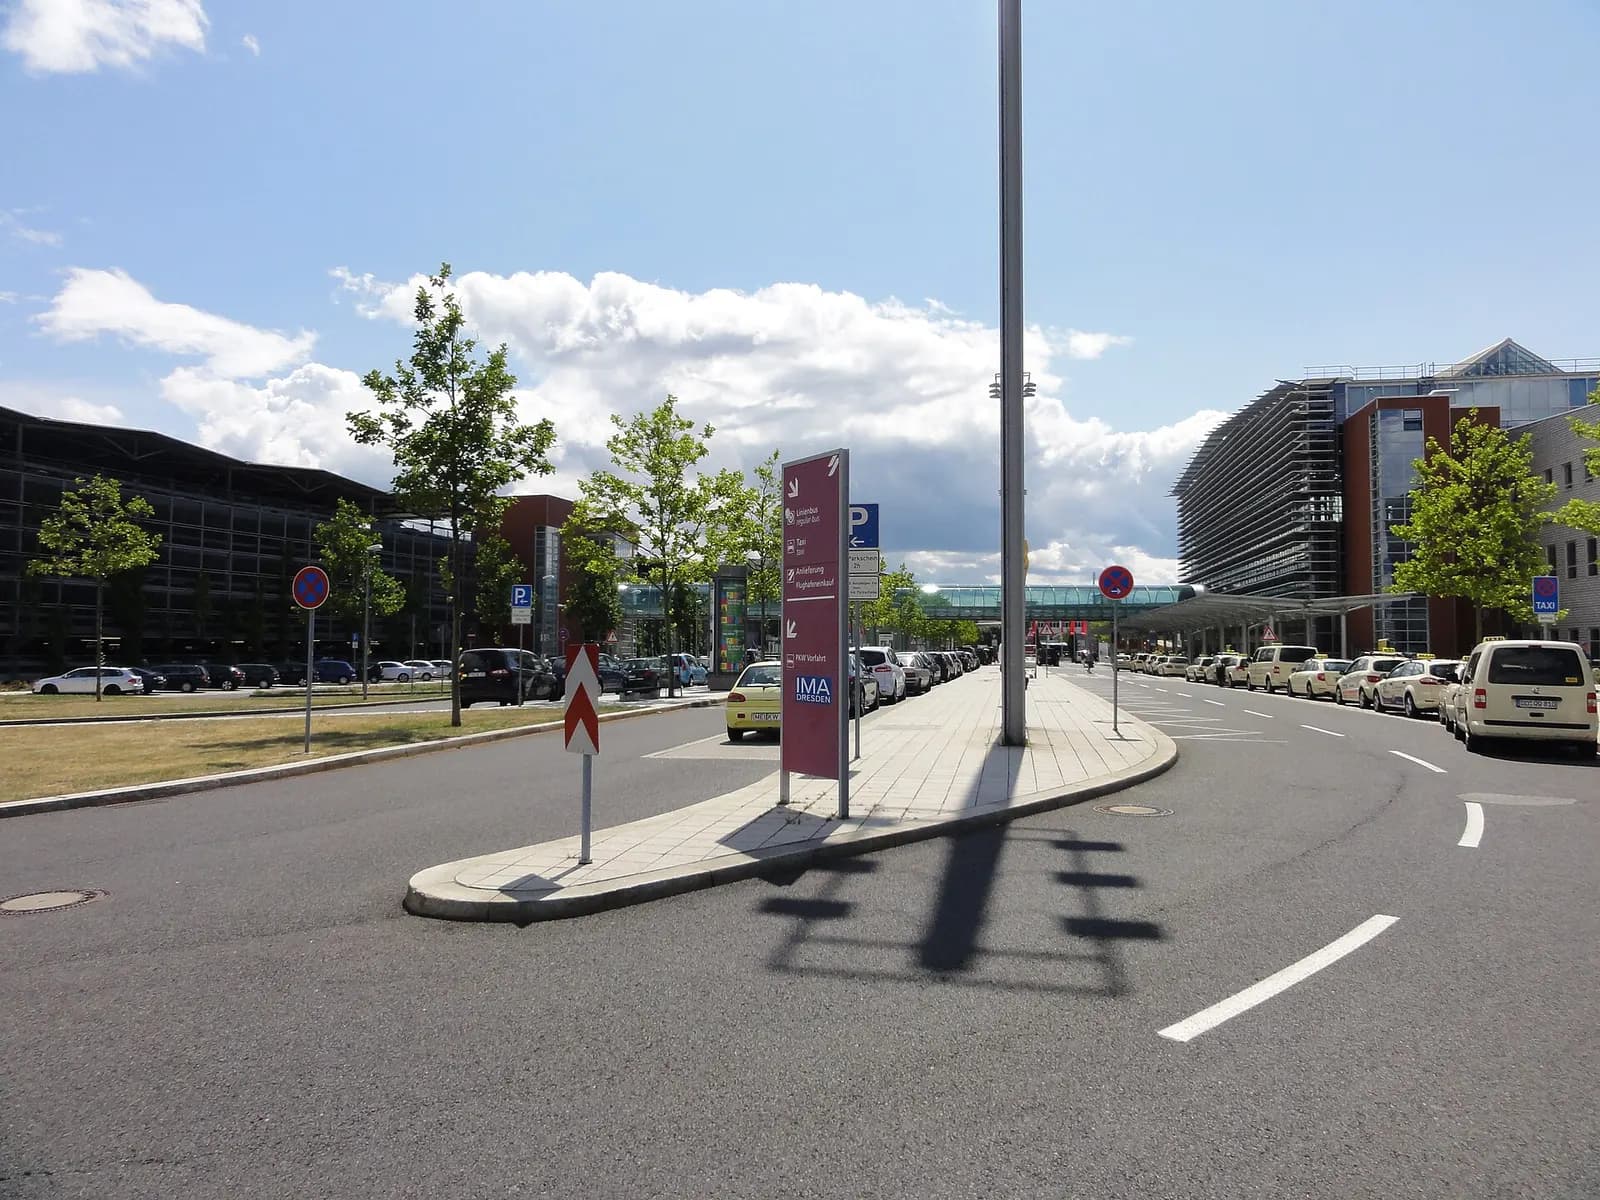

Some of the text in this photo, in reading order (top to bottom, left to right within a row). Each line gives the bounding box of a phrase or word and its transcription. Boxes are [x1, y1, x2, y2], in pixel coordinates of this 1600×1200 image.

[849, 507, 868, 535] P
[515, 588, 525, 604] P
[797, 677, 830, 695] IMA
[797, 694, 830, 703] DRESDEN
